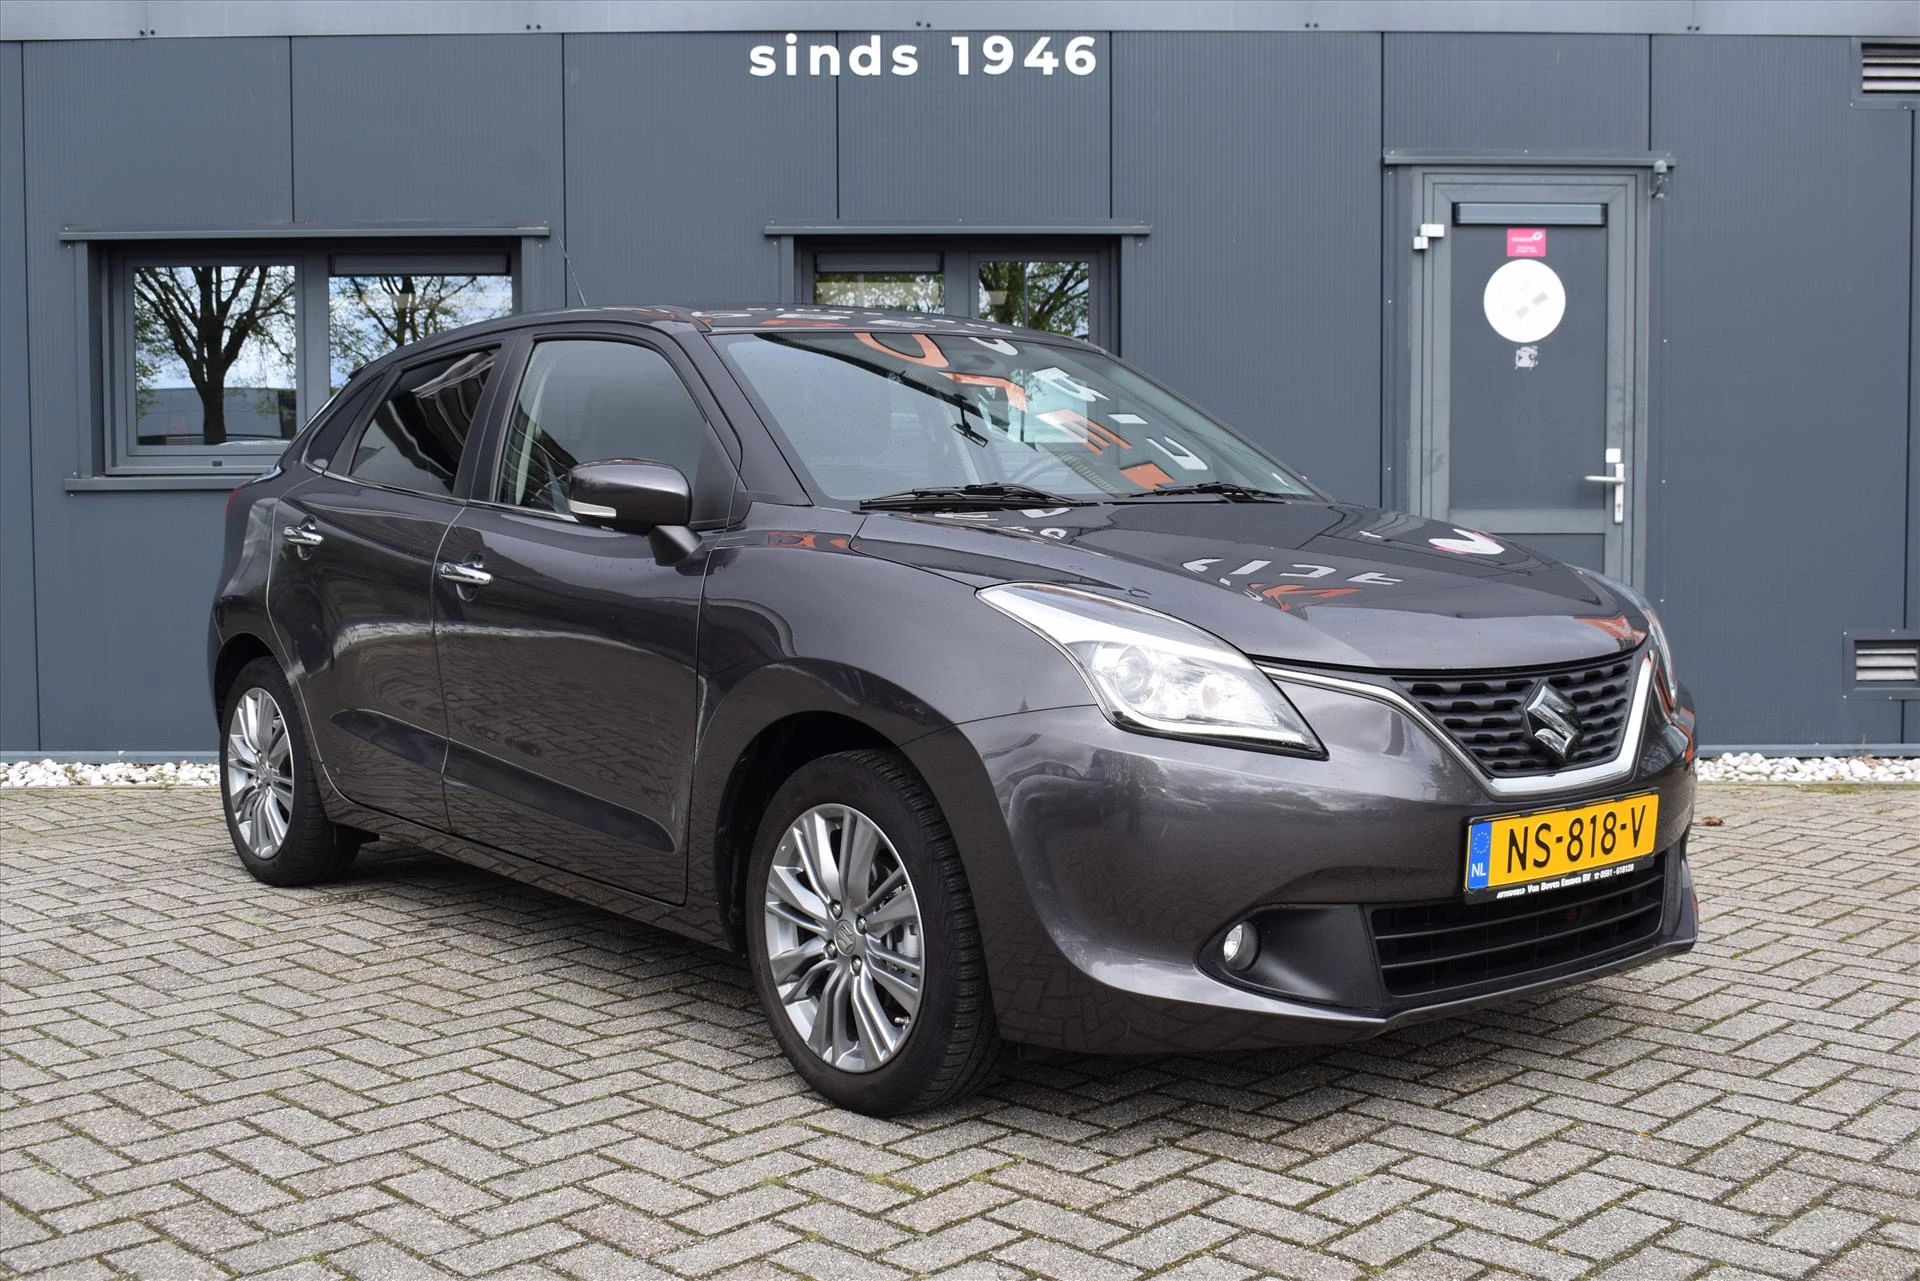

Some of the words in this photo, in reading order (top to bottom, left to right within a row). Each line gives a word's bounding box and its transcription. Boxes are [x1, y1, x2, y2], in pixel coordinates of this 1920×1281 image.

[749, 33, 919, 76] sinds
[951, 35, 1097, 76] 1946
[1507, 805, 1646, 873] NS-818-V
[1471, 863, 1487, 878] NL
